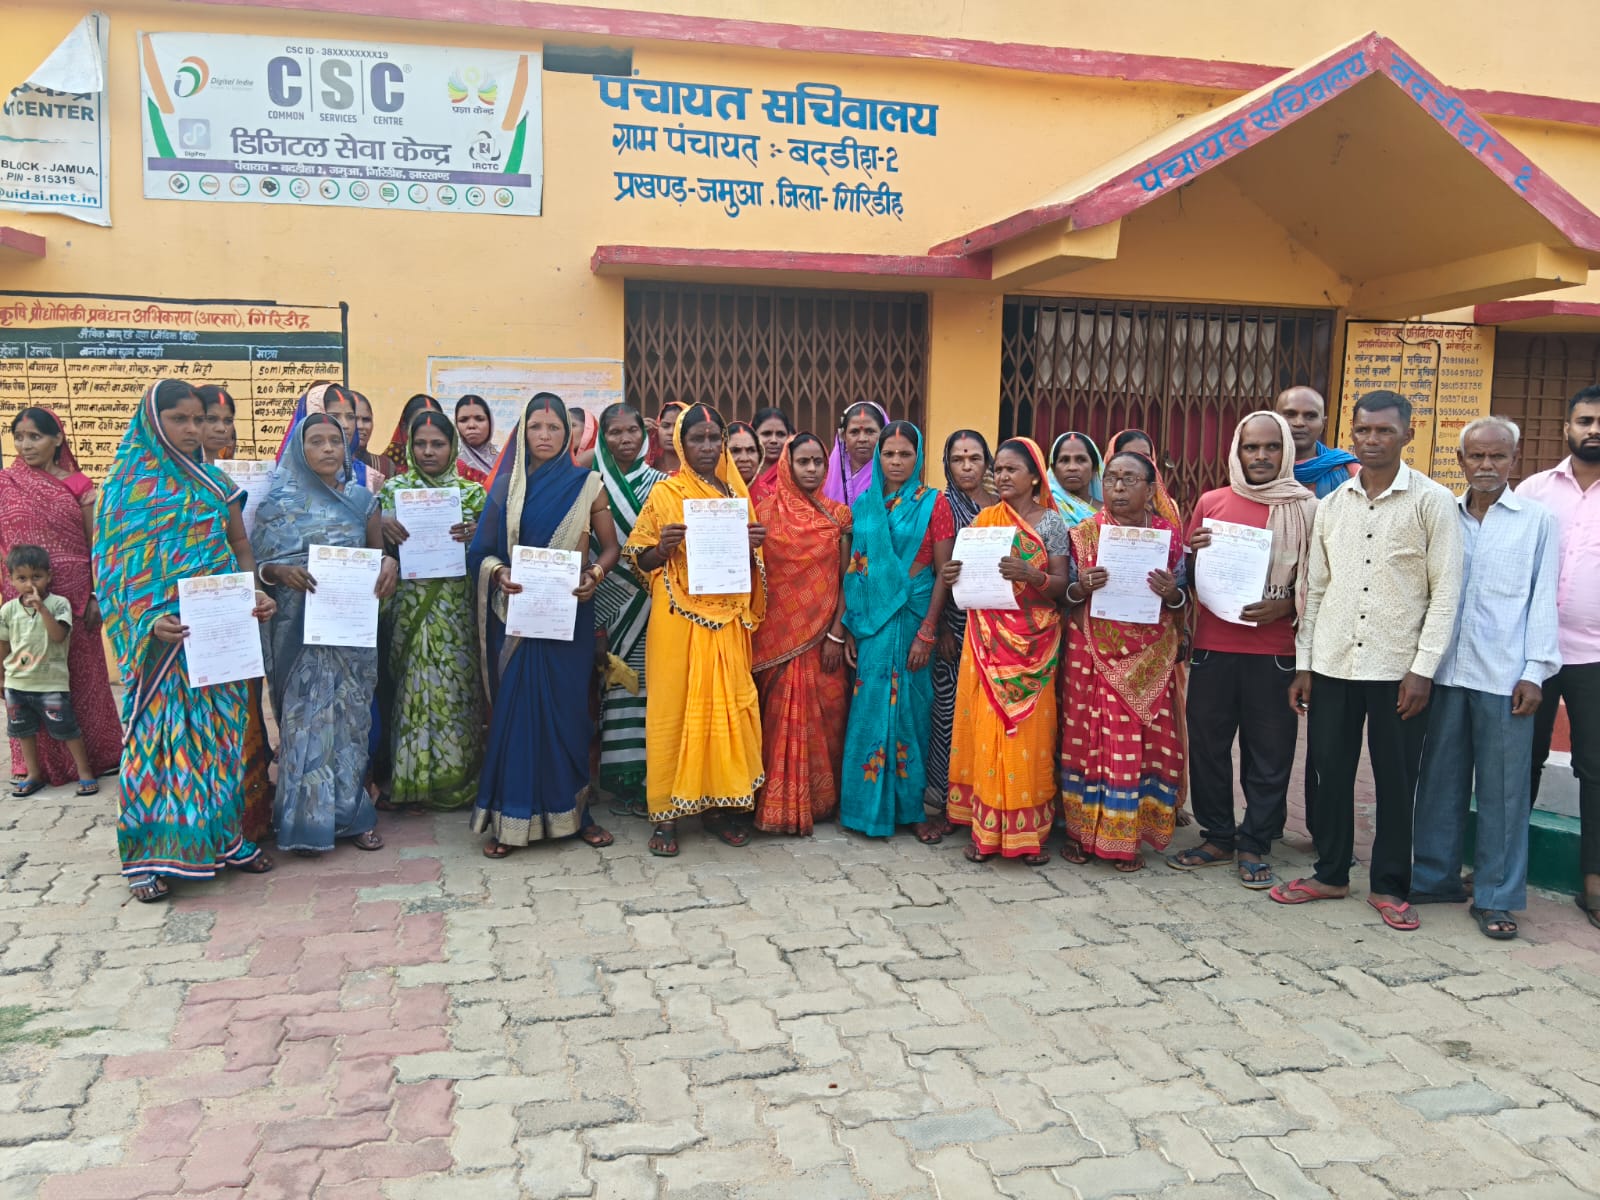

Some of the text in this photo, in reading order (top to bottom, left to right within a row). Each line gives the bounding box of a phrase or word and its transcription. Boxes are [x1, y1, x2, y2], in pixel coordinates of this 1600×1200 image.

[285, 46, 303, 54] CSC
[305, 47, 315, 55] ID
[210, 78, 235, 86] Digital
[16, 100, 95, 121] CENTER
[593, 68, 939, 137] पंचायत सचिवालय
[268, 110, 404, 126] COMMON SERVICES CENTRE
[1132, 50, 1371, 193] पंचायत सचिवालय
[229, 127, 453, 166] डिजिटल सेवा केन्द्र
[612, 123, 659, 156] ग्राम
[662, 122, 761, 169] पंचायत
[49, 163, 99, 177] JAMUA,
[234, 161, 269, 172] पंचायत
[366, 166, 406, 179] गिरिडीह,
[408, 170, 451, 181] झारखण्ड
[472, 162, 499, 170] IRCTC
[6, 171, 24, 182] PIN
[34, 174, 76, 185] 815315
[1514, 165, 1533, 193] 2
[832, 181, 904, 222] गिरिडीह
[86, 304, 132, 325] प्रबंधन
[132, 305, 194, 326] अभिकरण
[247, 308, 311, 330] गिरिडीह
[256, 348, 279, 360] मात्रा
[257, 385, 274, 394] 200
